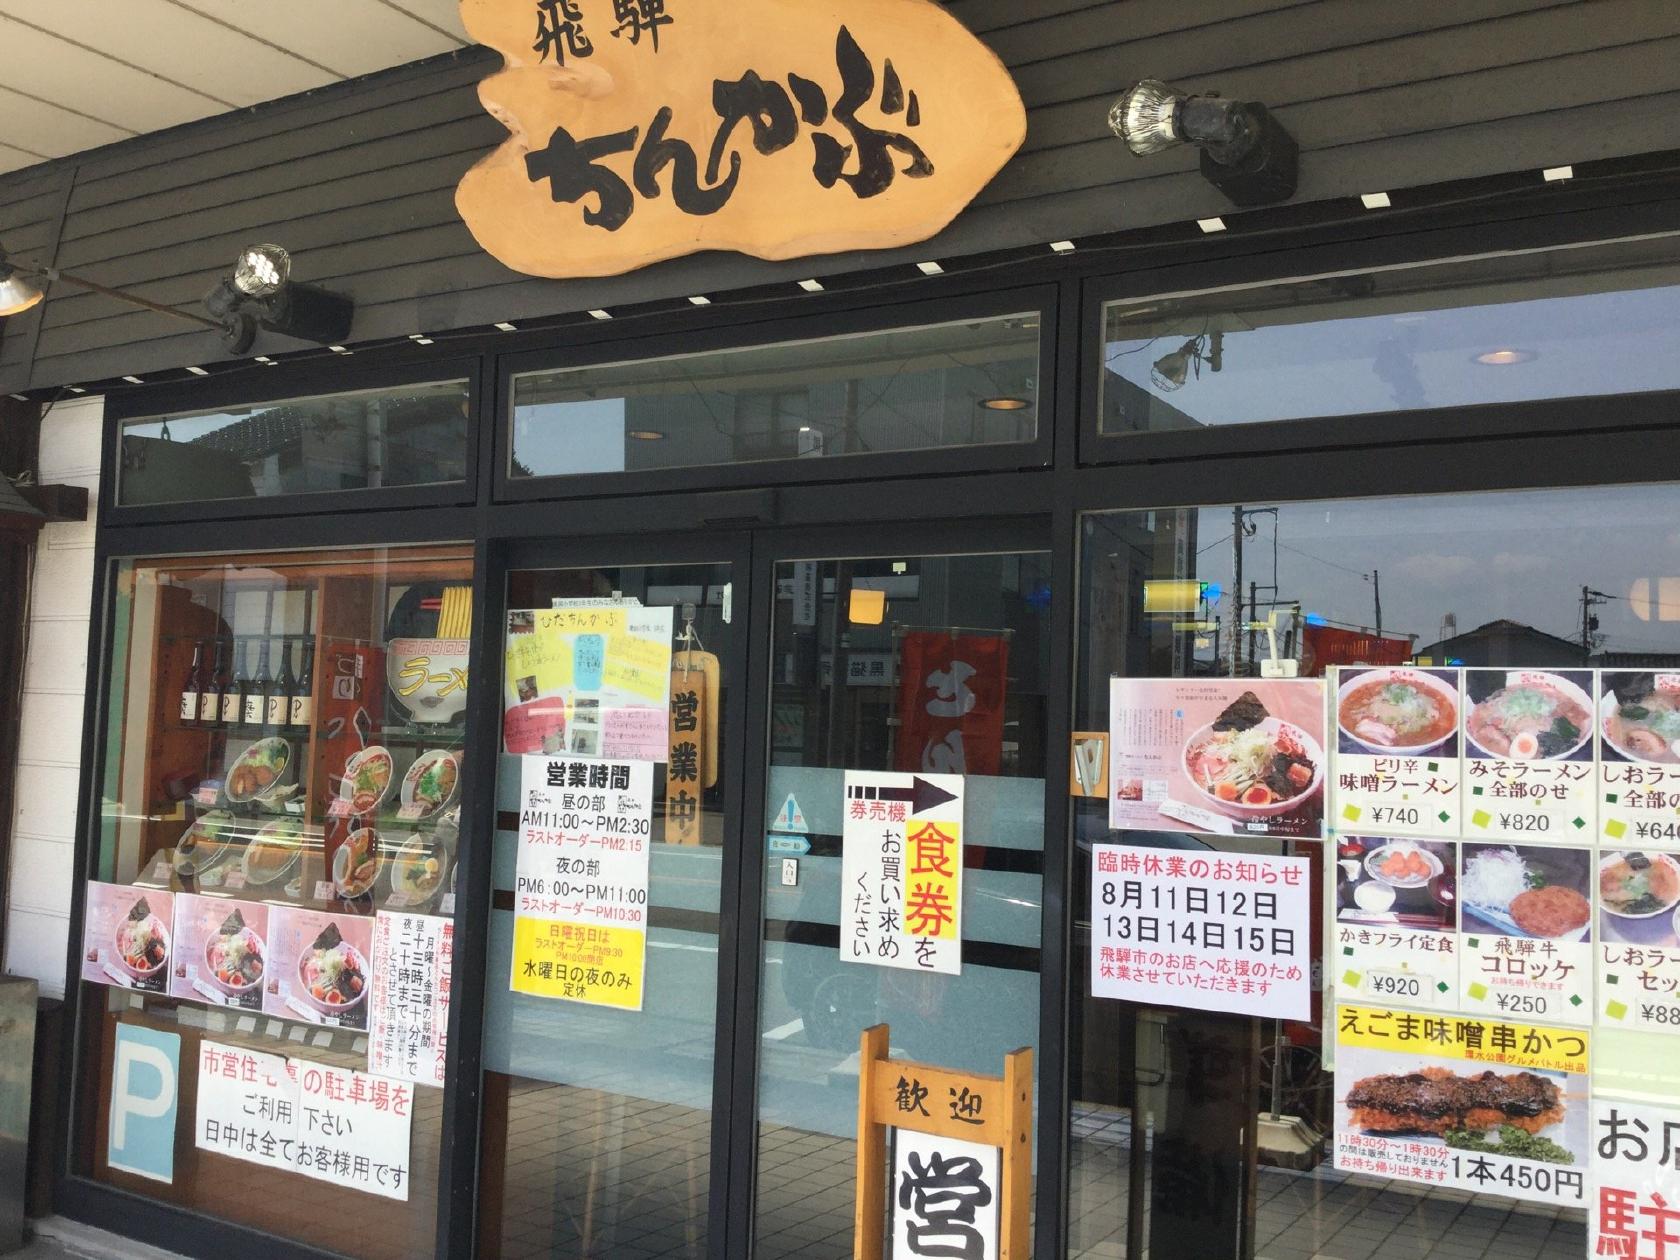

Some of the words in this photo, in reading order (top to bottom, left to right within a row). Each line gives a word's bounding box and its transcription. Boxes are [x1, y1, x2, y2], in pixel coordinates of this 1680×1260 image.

[525, 25, 935, 231] ちんかぶ
[669, 690, 699, 831] 営業中
[1374, 758, 1419, 774] ピリ辛
[1469, 760, 1592, 780] みそラーメン
[546, 762, 631, 791] 営業時間
[1339, 773, 1458, 795] 味噌ラーメン
[1489, 780, 1569, 800] 全部のせ
[561, 793, 606, 813] 昼の部
[850, 801, 907, 822] 券売機
[1372, 806, 1419, 825] ¥740
[1499, 812, 1550, 831] ¥820
[1635, 821, 1680, 842] ¥64
[525, 829, 642, 852] ラストオーダーPM2:15
[556, 857, 601, 877] 夜の部
[1097, 850, 1303, 886] 臨時休業のお知らせ
[877, 828, 901, 960] お買い求め
[905, 821, 956, 969] 食券を
[1101, 880, 1278, 920] 8月11日12日
[853, 871, 873, 958] ください
[550, 924, 611, 944] 日曜祝日は
[1103, 914, 1295, 957] 13日14日15日
[1340, 927, 1454, 954] かきフライ定食
[1494, 936, 1558, 959] 飛騨牛
[396, 917, 412, 1019] 夜二十時まで
[523, 958, 633, 990] 水曜日の夜のみ
[1099, 946, 1303, 982] 飛騨市のお店へ応援のため
[1481, 954, 1575, 981] コロッケ
[563, 982, 587, 998] 定休
[1099, 963, 1272, 996] 休業させていただきます
[1373, 975, 1420, 996] ¥920
[406, 919, 425, 1076] 昼十三時三十分まで
[1496, 992, 1547, 1014] ¥250
[1340, 1008, 1587, 1058] えごま味噌串かつ
[115, 1040, 176, 1149] P
[894, 1075, 985, 1125] 歓迎
[205, 1118, 408, 1190] 日中は全てお客様用です
[1340, 1155, 1448, 1182] お持ち帰り出来ます
[1451, 1154, 1584, 1200] 1本450円
